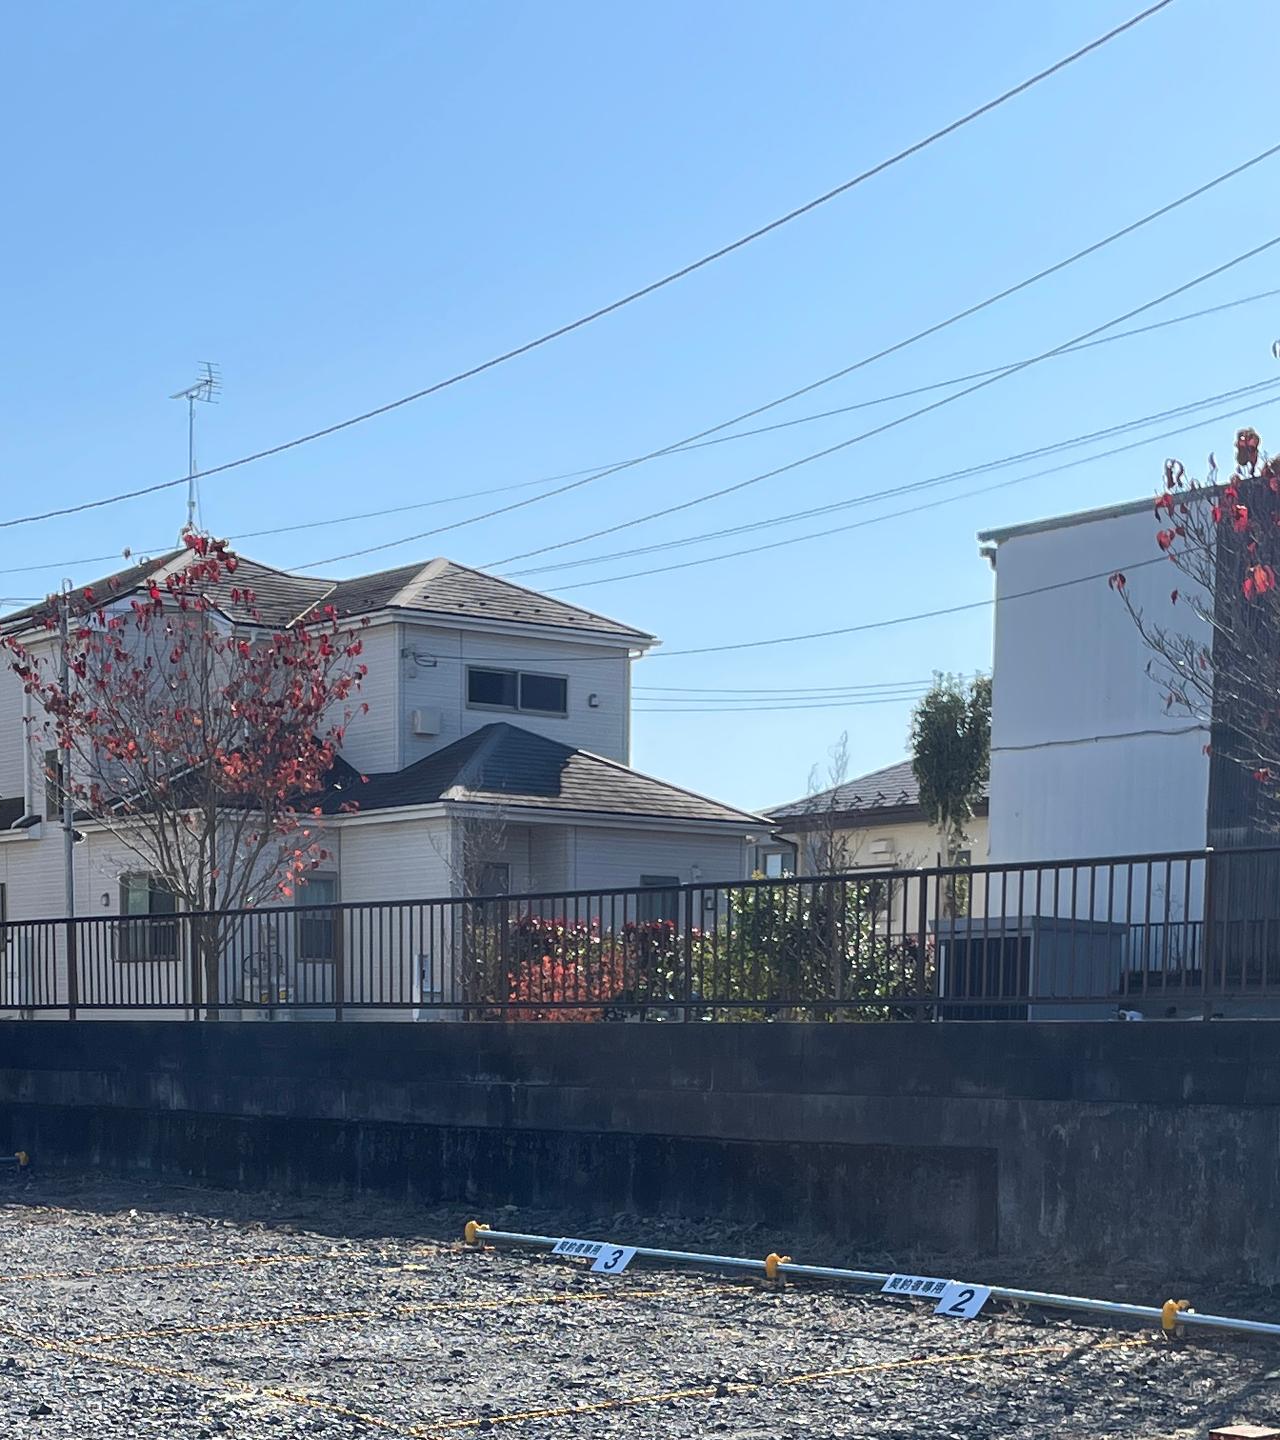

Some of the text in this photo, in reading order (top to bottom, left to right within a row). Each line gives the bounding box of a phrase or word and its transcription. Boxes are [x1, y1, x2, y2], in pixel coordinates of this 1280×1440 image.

[604, 1249, 624, 1270] 3
[887, 1278, 975, 1313] 契約者専用 2
